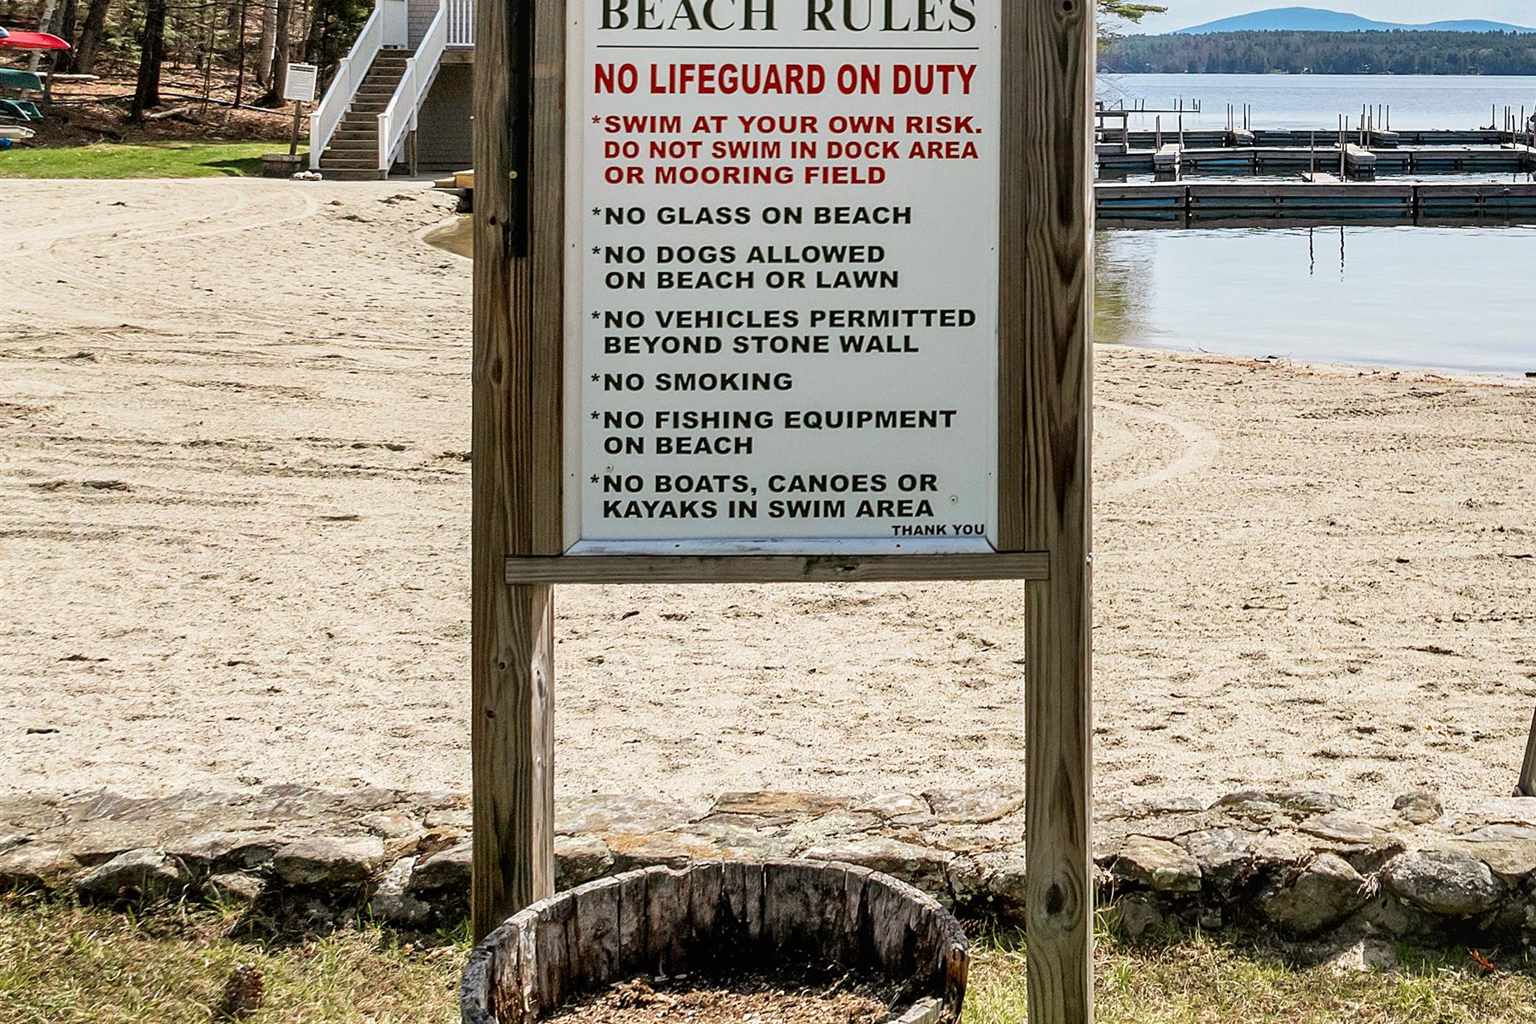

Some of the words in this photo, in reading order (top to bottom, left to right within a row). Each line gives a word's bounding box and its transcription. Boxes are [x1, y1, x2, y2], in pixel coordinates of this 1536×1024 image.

[594, 62, 639, 95] NO
[650, 63, 826, 95] LIFEGUARD
[836, 63, 881, 96] ON
[892, 64, 977, 96] DUTY
[691, 115, 729, 134] AT
[737, 115, 819, 134] YOUR
[828, 115, 895, 134] OWN
[905, 115, 983, 134] RISK.
[604, 140, 640, 159] DO
[649, 140, 704, 160] NOT
[711, 140, 781, 160] SWIM
[790, 140, 817, 160] IN
[826, 140, 900, 160] DOCK
[908, 140, 979, 160] AREA
[604, 165, 645, 185] OR
[655, 166, 794, 185] MOORING
[804, 166, 886, 185] FIELD
[656, 206, 751, 225] GLASS
[761, 206, 803, 225] ON
[813, 206, 912, 225] BEACH
[656, 245, 737, 264] DOGS
[745, 245, 885, 264] ALLOWED
[604, 271, 646, 290] ON
[656, 270, 755, 290] BEACH
[765, 270, 807, 290] OR
[816, 270, 899, 289] LAWN
[654, 309, 800, 329] VEHICLES
[809, 308, 977, 329] PERMITTED
[603, 335, 723, 355] BEYOND
[732, 335, 830, 354] STONE
[838, 334, 920, 354] WALL
[654, 372, 793, 392] SMOKING
[655, 410, 774, 430] FISHING
[783, 409, 958, 431] EQUIPMENT
[603, 436, 645, 455] ON
[655, 436, 753, 455] BEACH
[654, 474, 758, 497] BOATS,
[767, 473, 888, 494] CANOES
[897, 473, 939, 493] OR
[602, 499, 718, 519] KAYAKS
[728, 499, 758, 519] IN
[767, 499, 846, 519] SWIM
[855, 498, 935, 519] AREA
[891, 524, 947, 536] THANK
[952, 523, 985, 535] YOU
